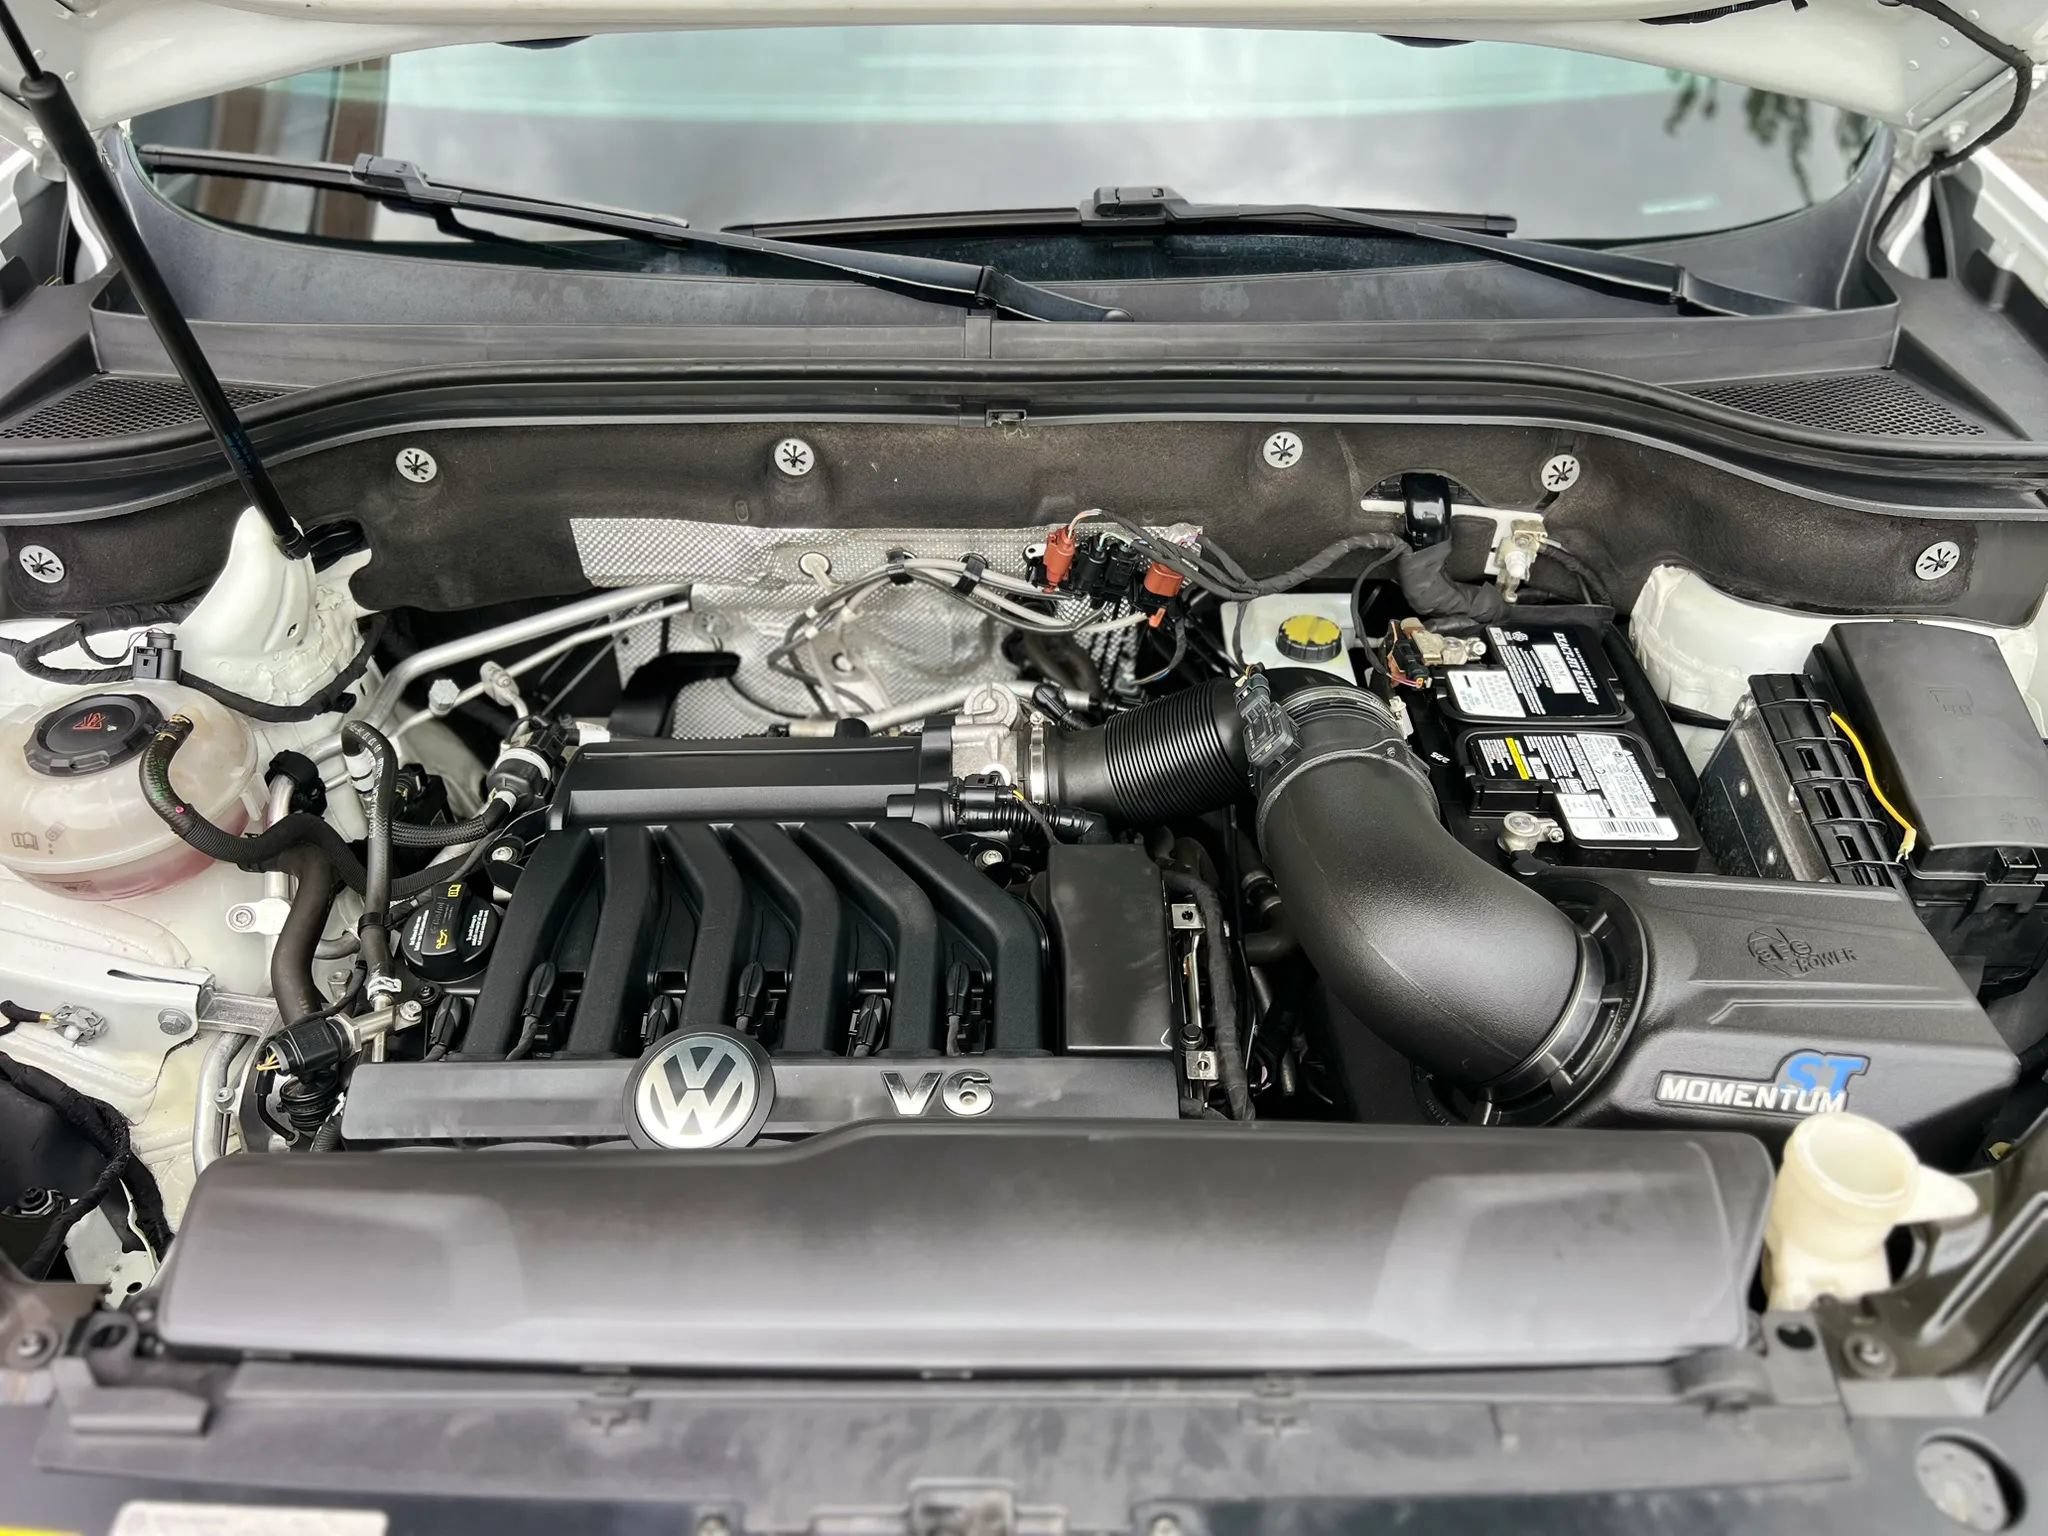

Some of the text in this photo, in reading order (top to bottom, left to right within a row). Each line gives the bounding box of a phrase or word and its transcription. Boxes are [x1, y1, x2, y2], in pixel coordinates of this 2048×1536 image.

[1553, 632, 1582, 671] EXACT-FIT
[1572, 669, 1599, 705] BATTERY
[1794, 947, 1857, 973] POWER
[881, 1068, 995, 1117] V6
[1659, 1077, 1847, 1113] MOMENTUM
[1784, 1056, 1864, 1101] ST
